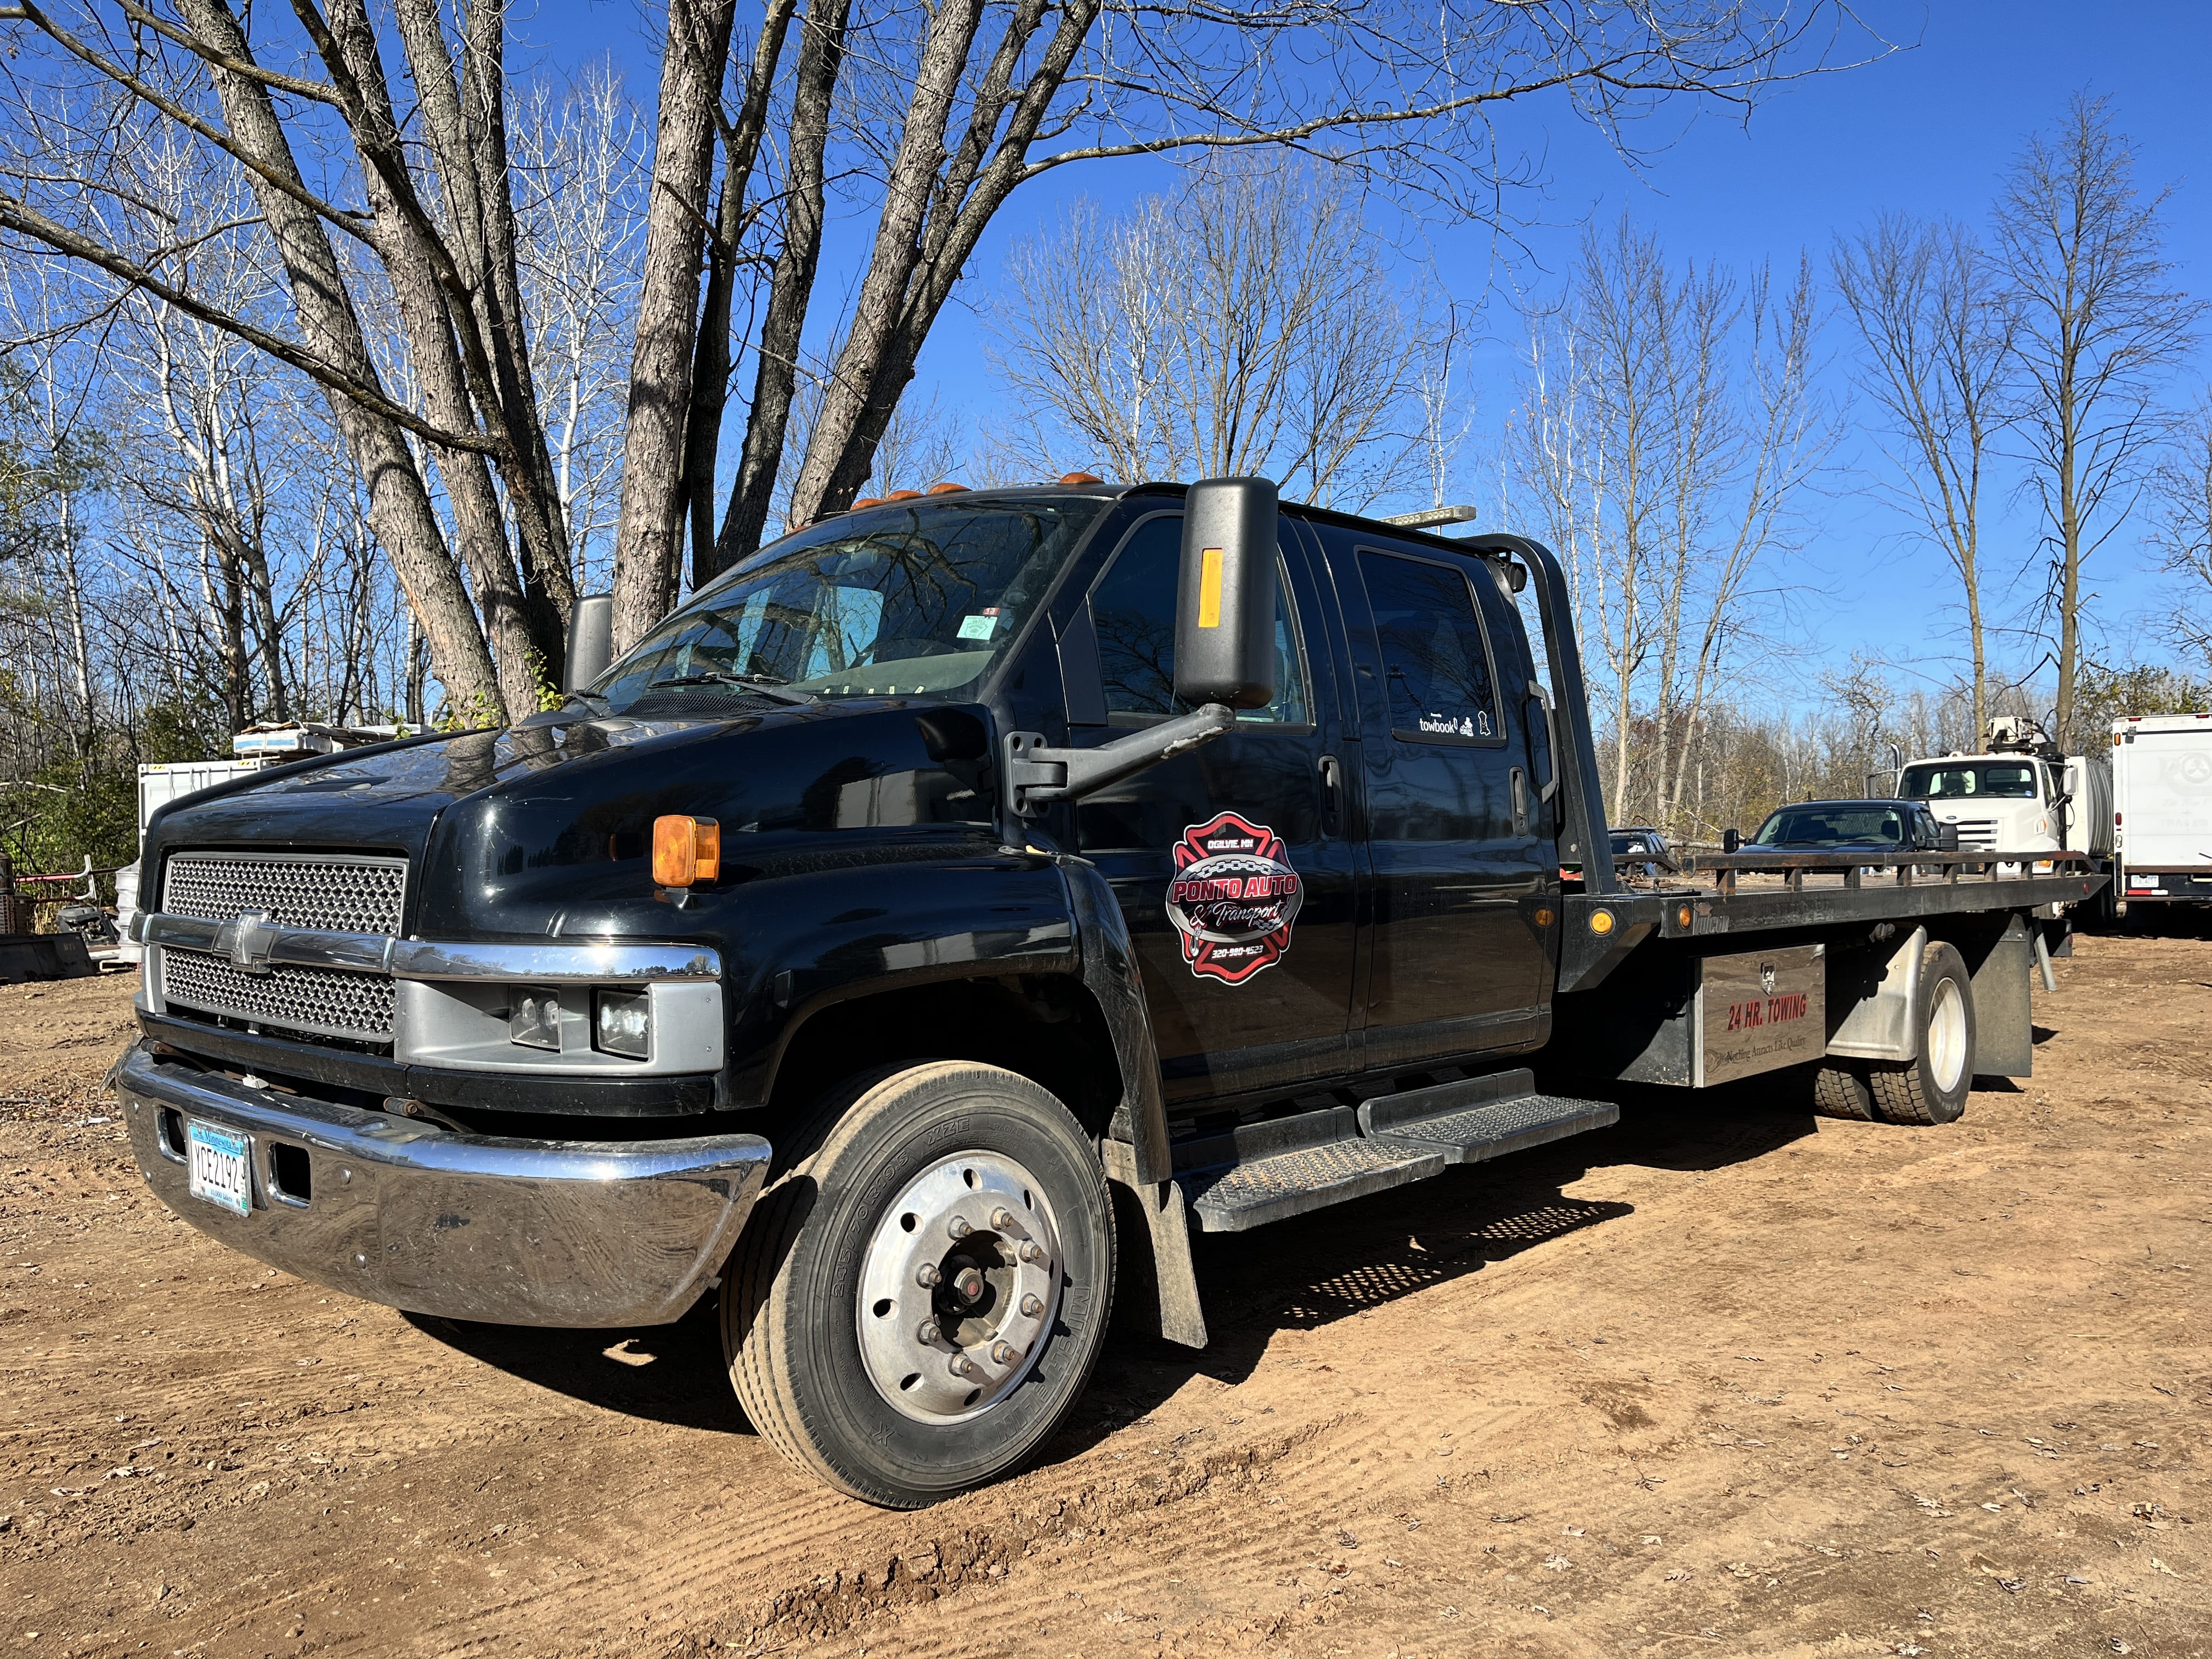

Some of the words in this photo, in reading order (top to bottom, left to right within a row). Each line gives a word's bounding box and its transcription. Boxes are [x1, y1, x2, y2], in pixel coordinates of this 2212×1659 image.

[1419, 718, 1454, 733] towbook
[1240, 839, 1254, 848] MN
[1172, 878, 1242, 903] PONTO
[1244, 874, 1297, 898] AUTO
[1189, 905, 1206, 927] &
[1211, 900, 1287, 927] Transport
[1728, 1003, 1742, 1032] 24
[1745, 1000, 1763, 1029] HR.
[1768, 992, 1808, 1024] TOWING
[1726, 1048, 1751, 1062] Nothing
[1752, 1045, 1773, 1057] Attracts
[1775, 1039, 1786, 1052] Like
[1787, 1035, 1806, 1051] Quality
[925, 1117, 970, 1146] XZE
[195, 1144, 239, 1194] YCE2192
[832, 1151, 911, 1299] 245/70R19.5
